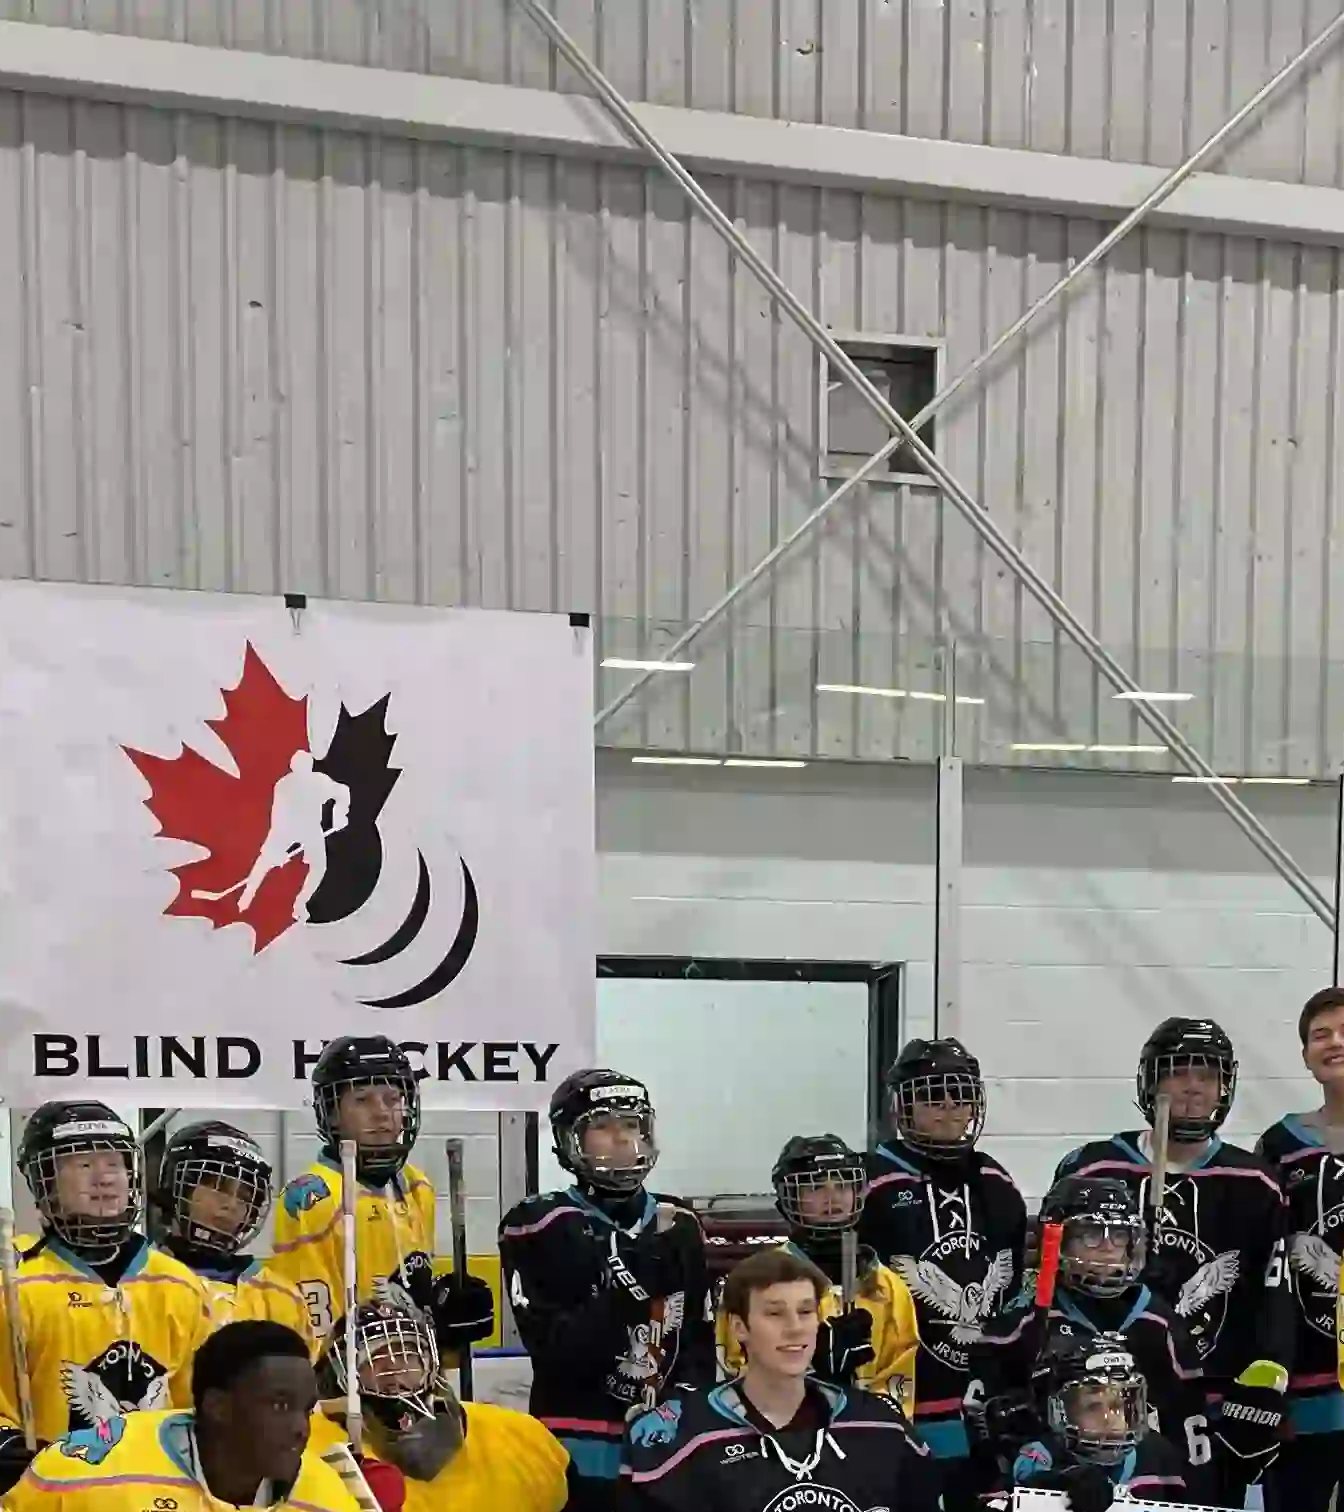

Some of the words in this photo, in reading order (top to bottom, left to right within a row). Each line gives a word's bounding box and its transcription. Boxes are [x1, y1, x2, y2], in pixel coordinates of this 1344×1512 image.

[31, 1032, 262, 1081] BLIND
[291, 1037, 561, 1083] HCKEY
[932, 1235, 981, 1261] TORON
[1222, 1400, 1282, 1427] ARRIOR
